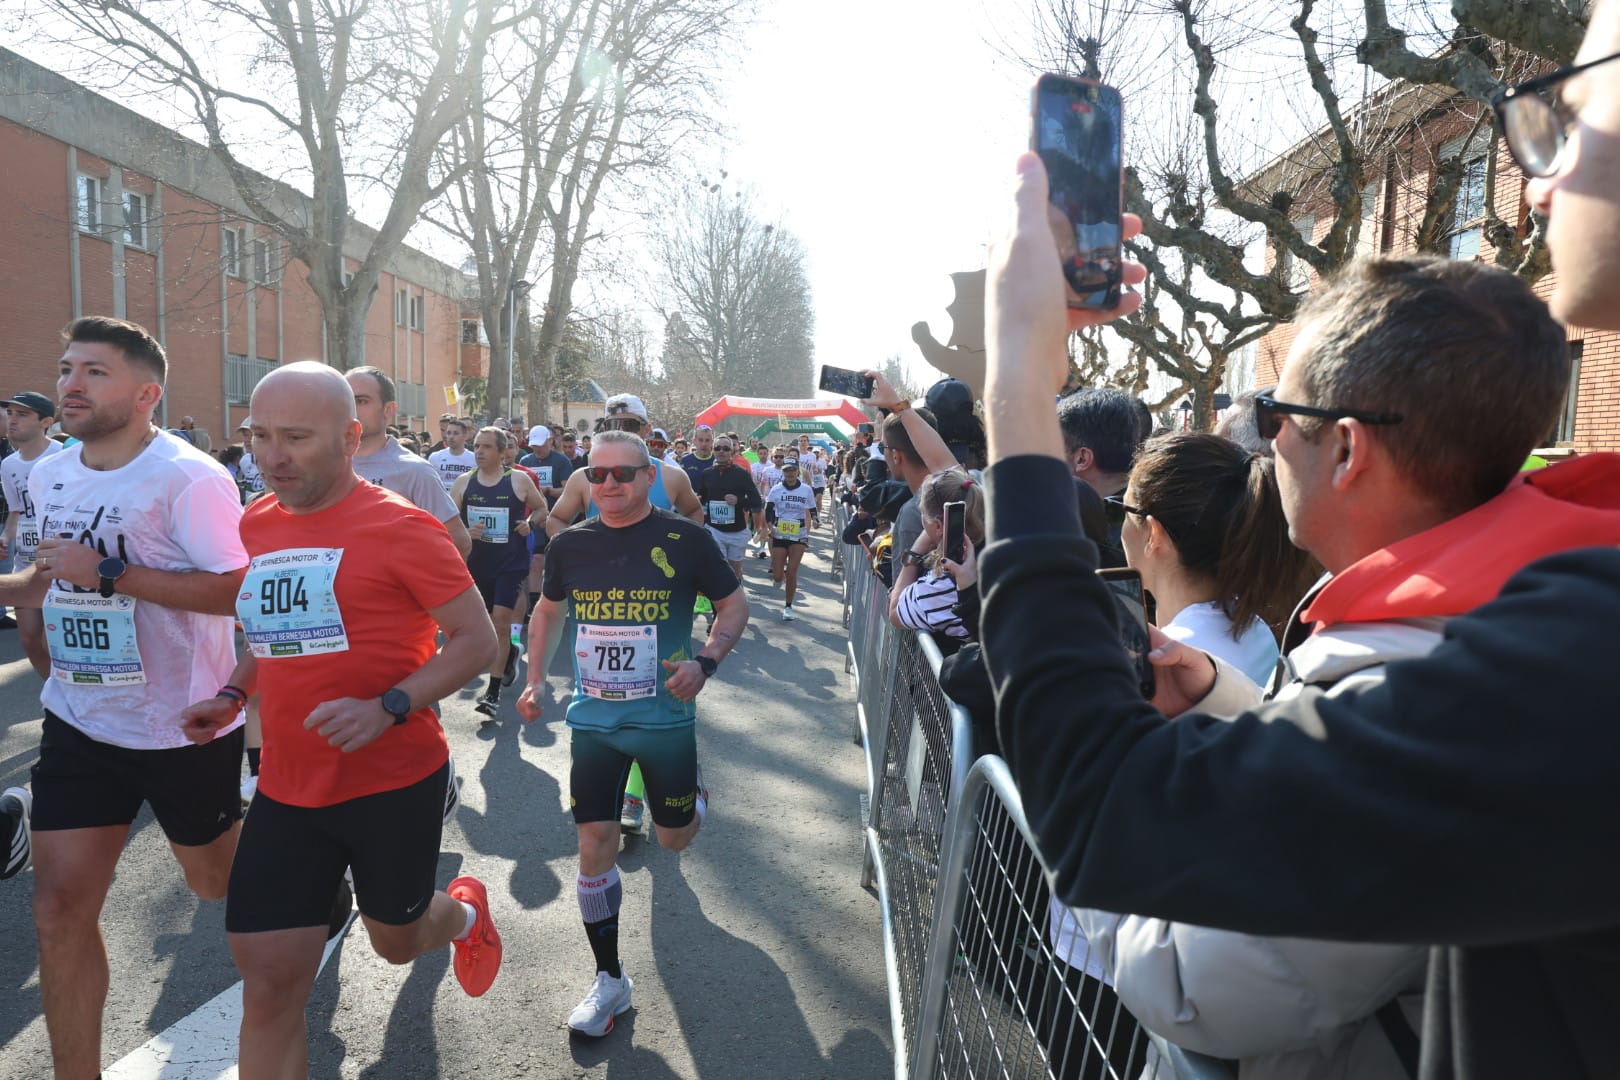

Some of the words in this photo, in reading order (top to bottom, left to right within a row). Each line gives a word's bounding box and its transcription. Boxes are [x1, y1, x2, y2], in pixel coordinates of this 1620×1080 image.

[440, 464, 472, 473] LIEBRE
[781, 496, 807, 504] LIEBRE
[260, 555, 291, 567] BERNESGA
[291, 554, 319, 562] MOTOR
[261, 576, 309, 615] 904
[572, 589, 602, 603] Grup
[607, 587, 625, 600] de
[630, 586, 672, 600] córrer
[55, 596, 86, 606] BERNESGA
[87, 598, 113, 607] MOTOR
[62, 617, 110, 650] 866
[278, 629, 313, 641] BERNESGA
[313, 627, 341, 637] MOTOR
[595, 646, 636, 671] 782
[81, 664, 112, 673] BERNESGA
[113, 664, 139, 673] MOTOR
